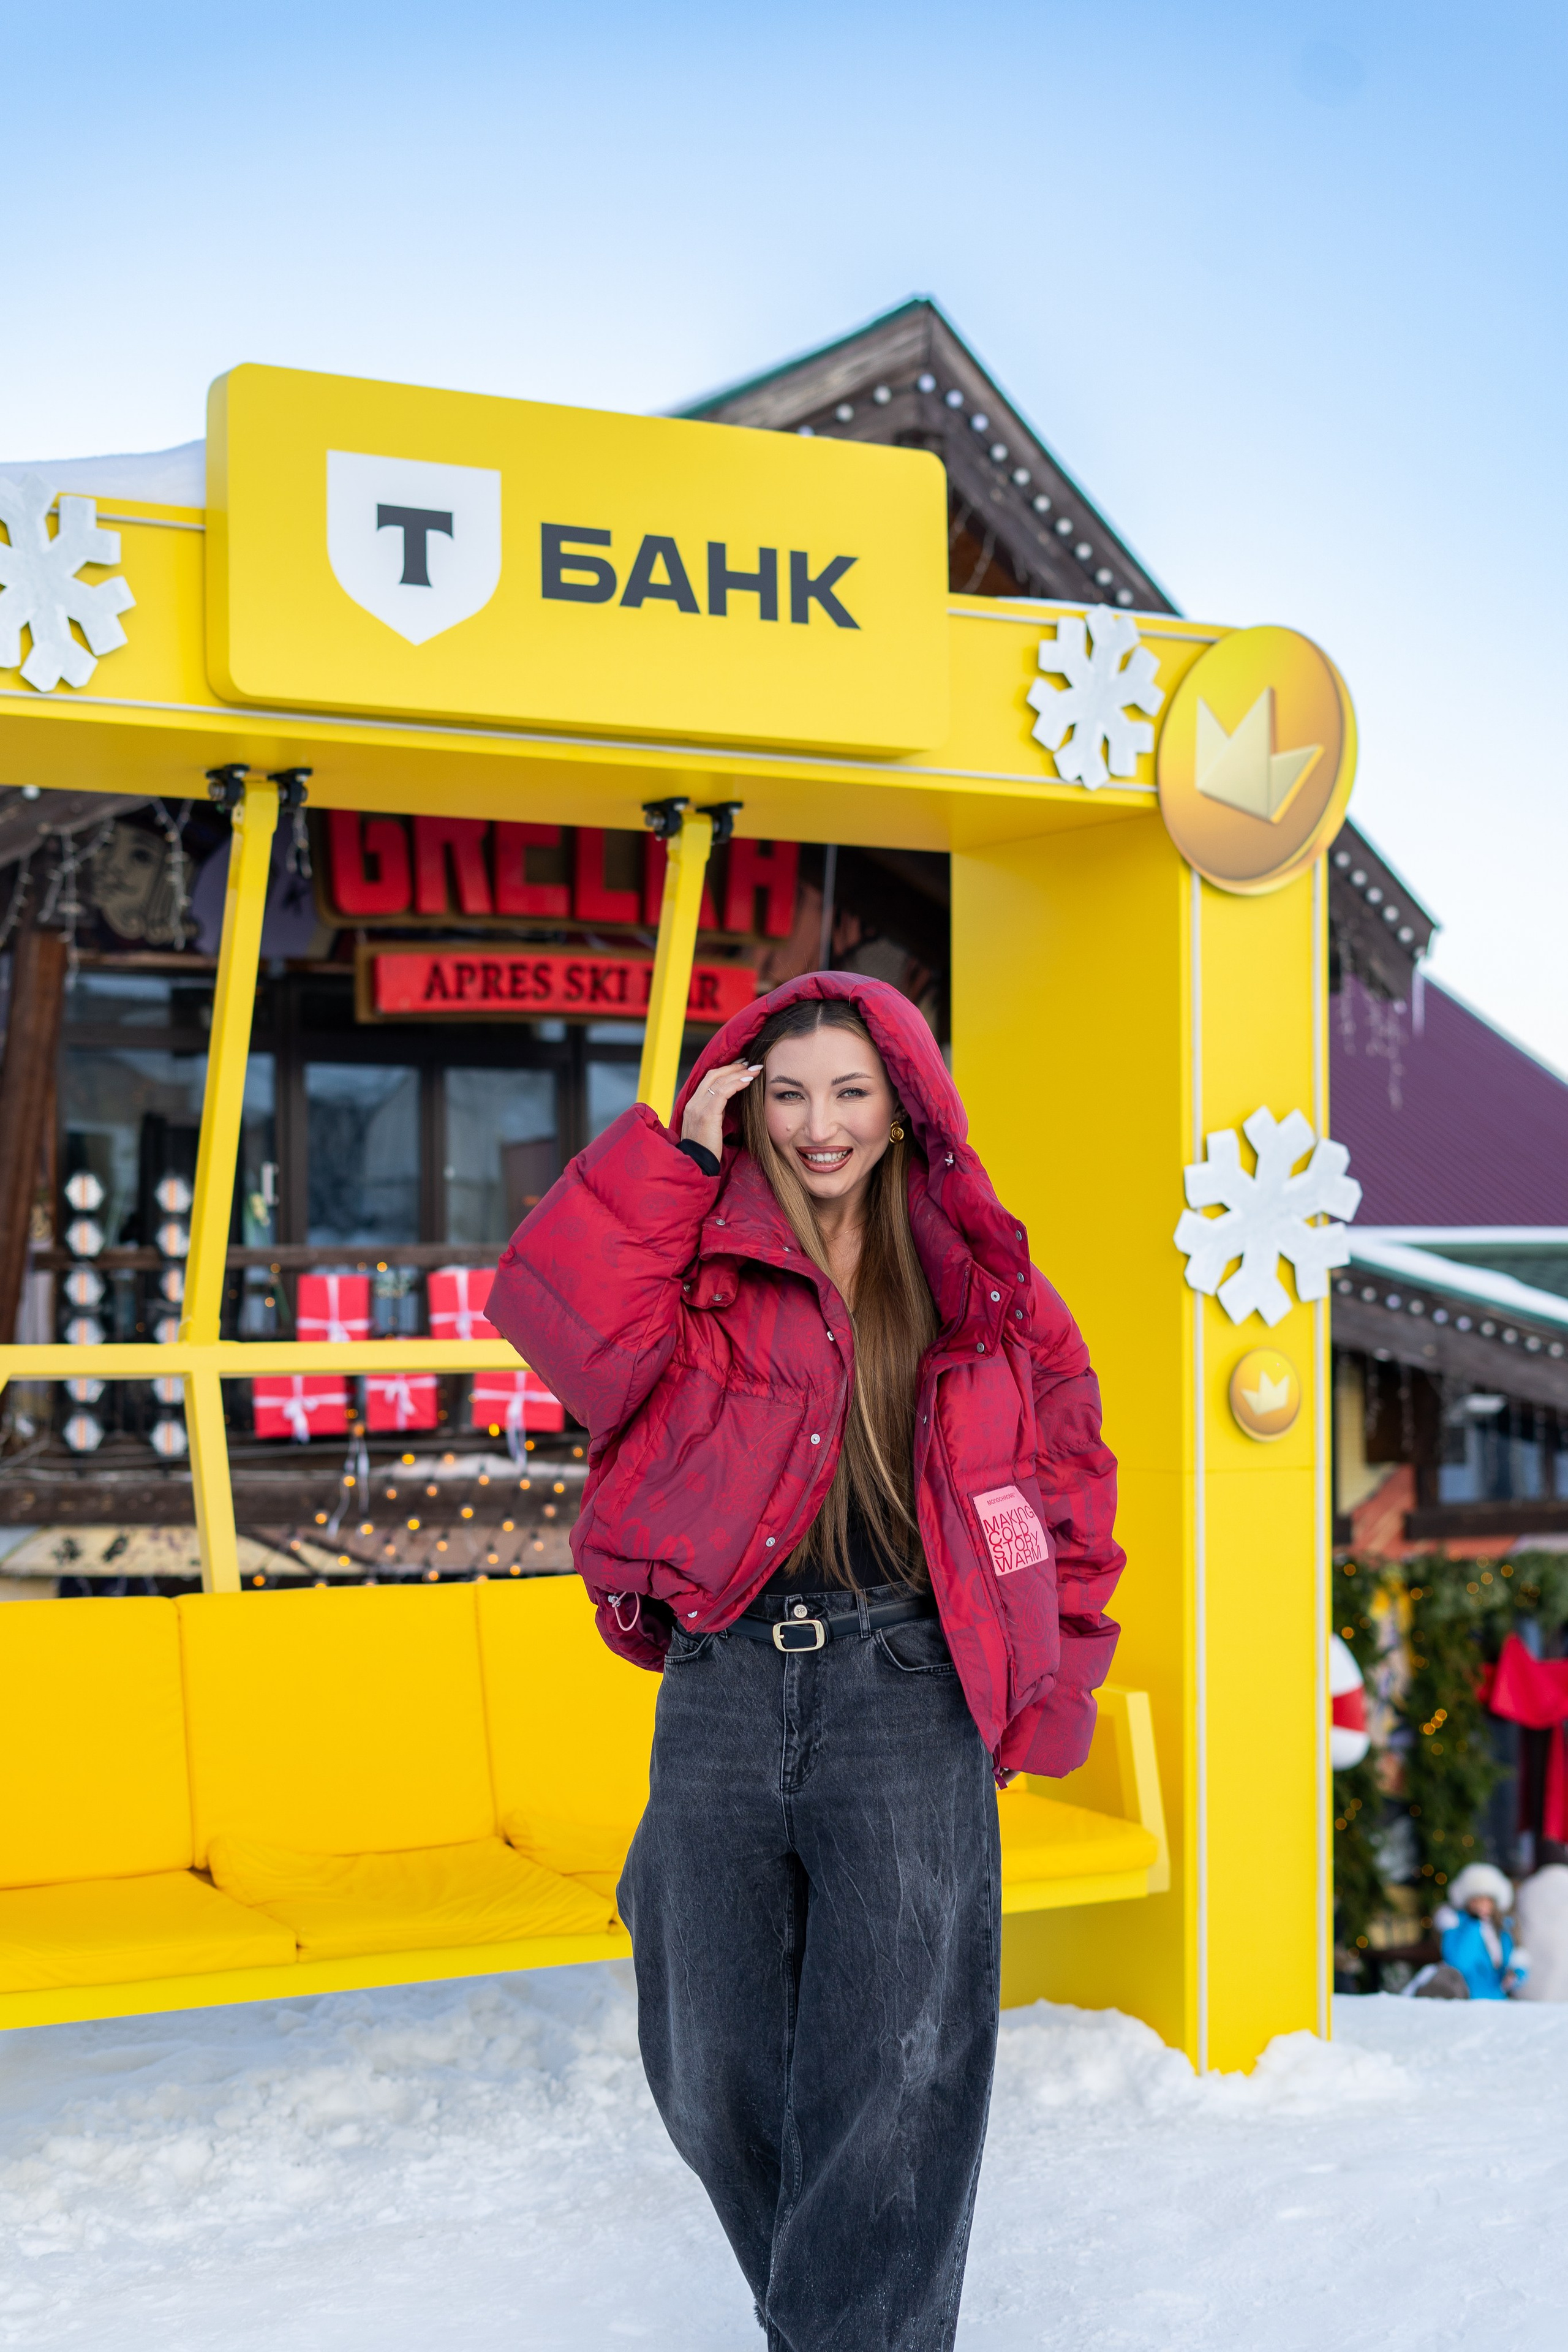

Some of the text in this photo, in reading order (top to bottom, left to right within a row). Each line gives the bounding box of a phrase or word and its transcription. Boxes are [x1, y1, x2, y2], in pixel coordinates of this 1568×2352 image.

[376, 503, 862, 630] Т БАНК
[425, 962, 552, 1001] APRES
[564, 965, 628, 1003] SKI
[983, 1506, 1035, 1534] MAKING
[989, 1521, 1029, 1546] COLD
[993, 1531, 1038, 1559] STORY
[995, 1545, 1042, 1572] WARM
